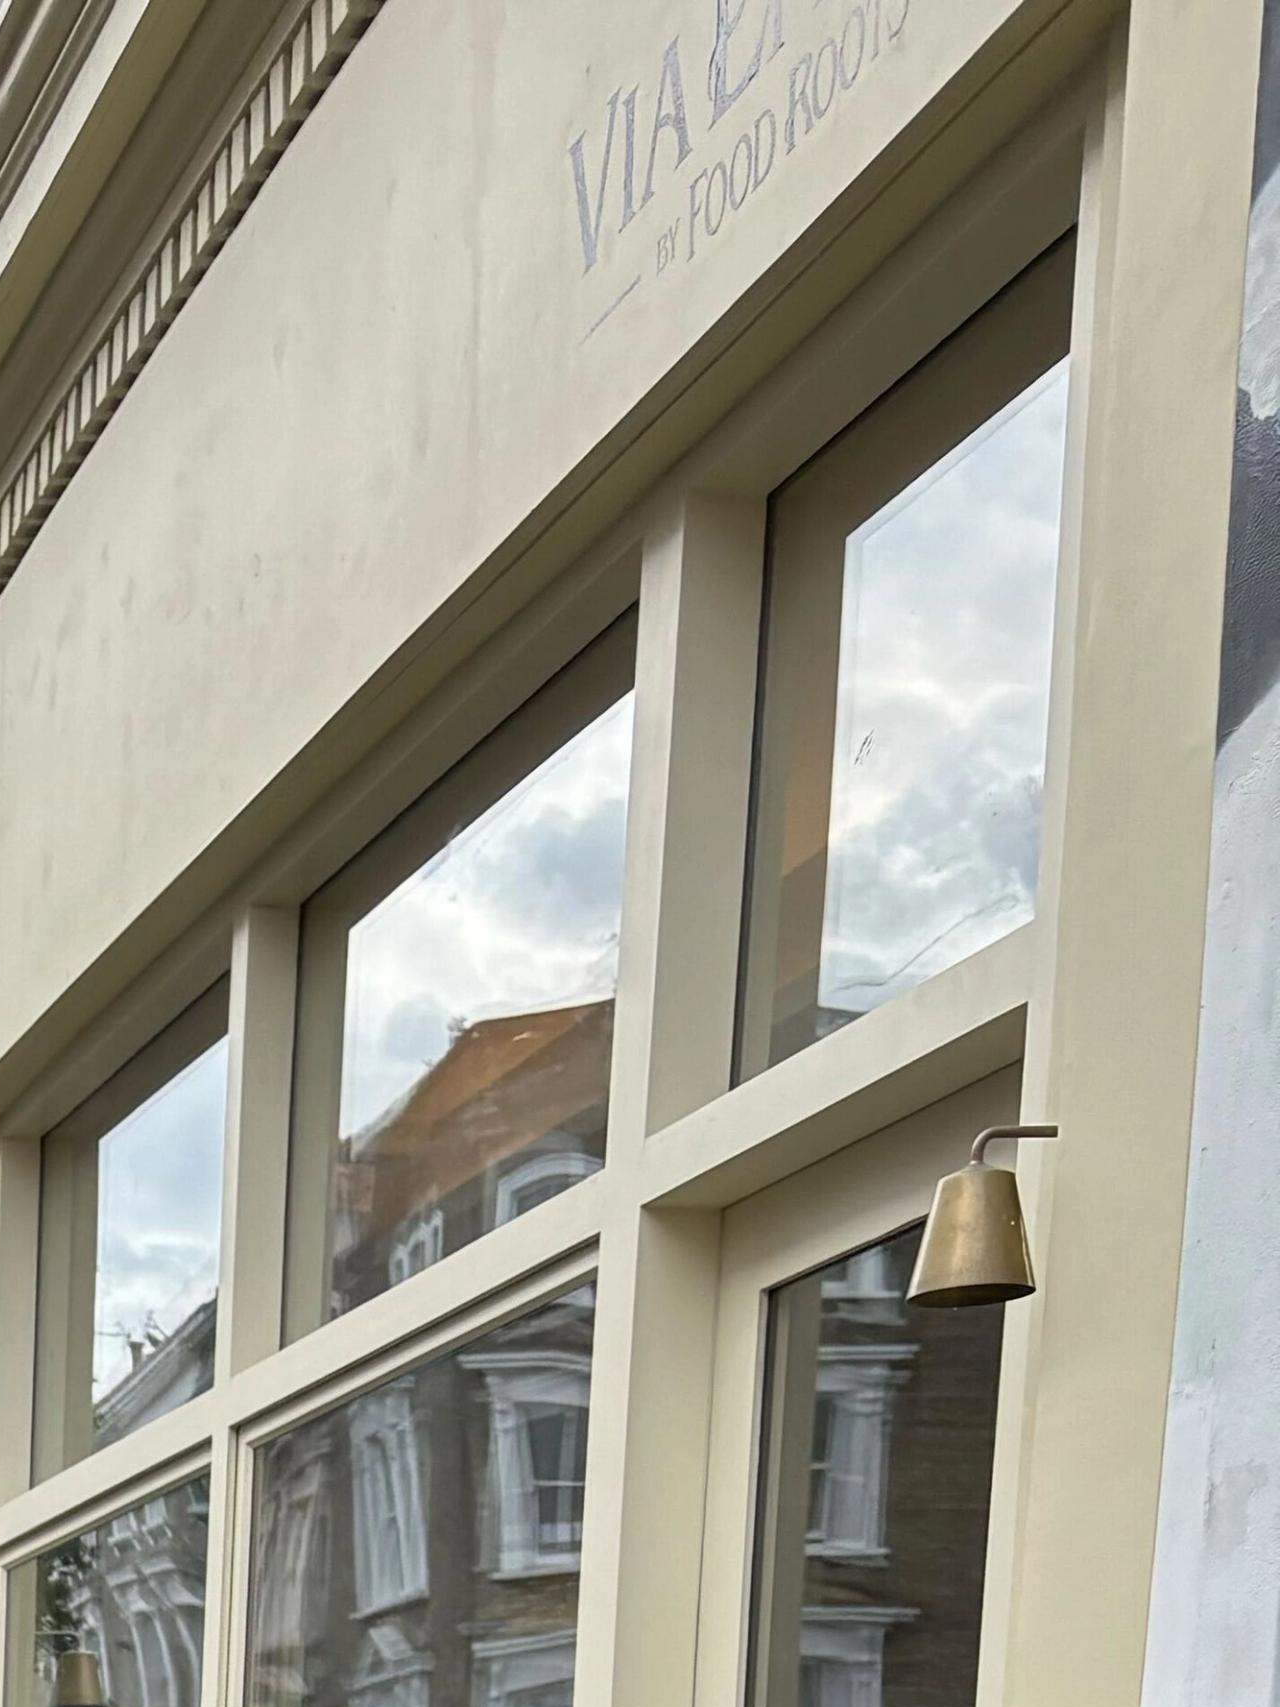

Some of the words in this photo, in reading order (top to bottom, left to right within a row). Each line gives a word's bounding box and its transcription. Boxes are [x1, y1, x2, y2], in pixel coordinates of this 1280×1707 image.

[567, 35, 693, 277] VIA
[657, 217, 680, 276] BY
[688, 108, 776, 262] FOOD
